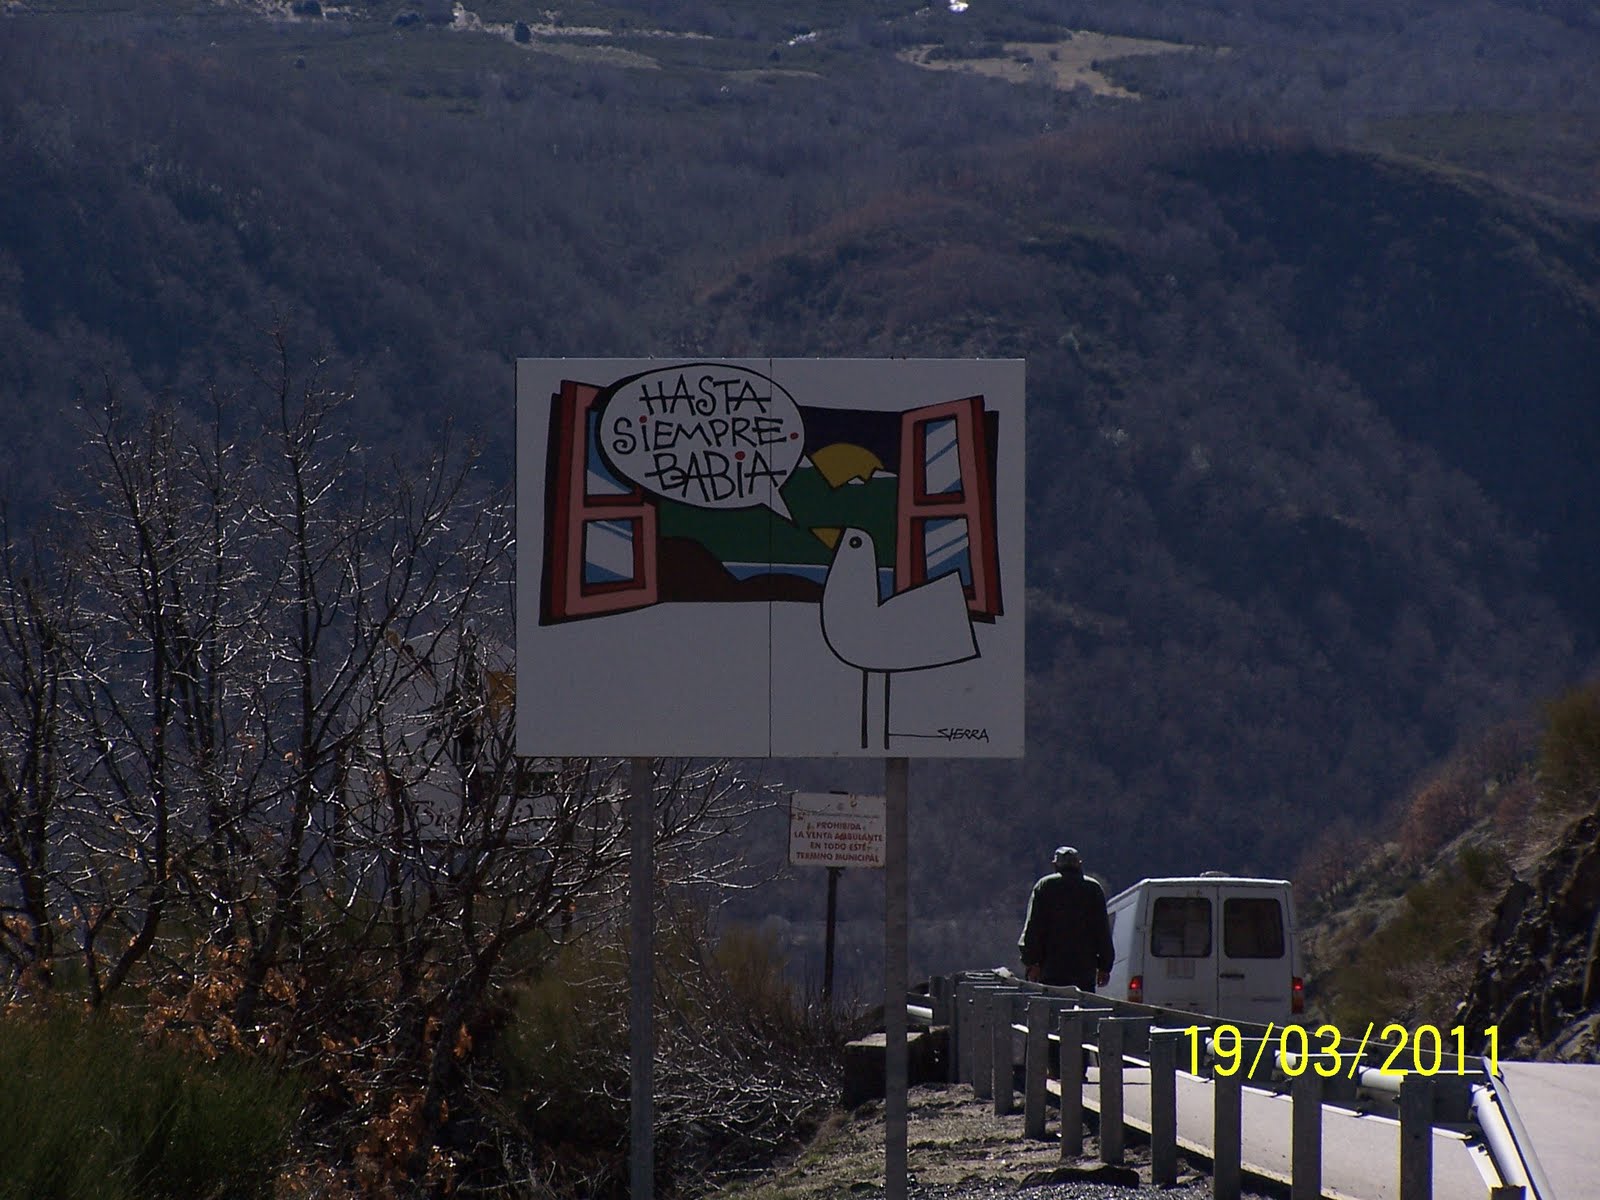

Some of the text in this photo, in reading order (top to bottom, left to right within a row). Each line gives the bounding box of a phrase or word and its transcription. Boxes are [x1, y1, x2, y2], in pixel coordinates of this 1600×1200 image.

[639, 374, 771, 416] HASTA
[816, 821, 862, 830] PROHIBIDA
[794, 831, 883, 842] LA VENTA AMBULANTE
[810, 841, 866, 851] EN TODO ESTE
[796, 851, 880, 863] TERMINO MUNICIPAL
